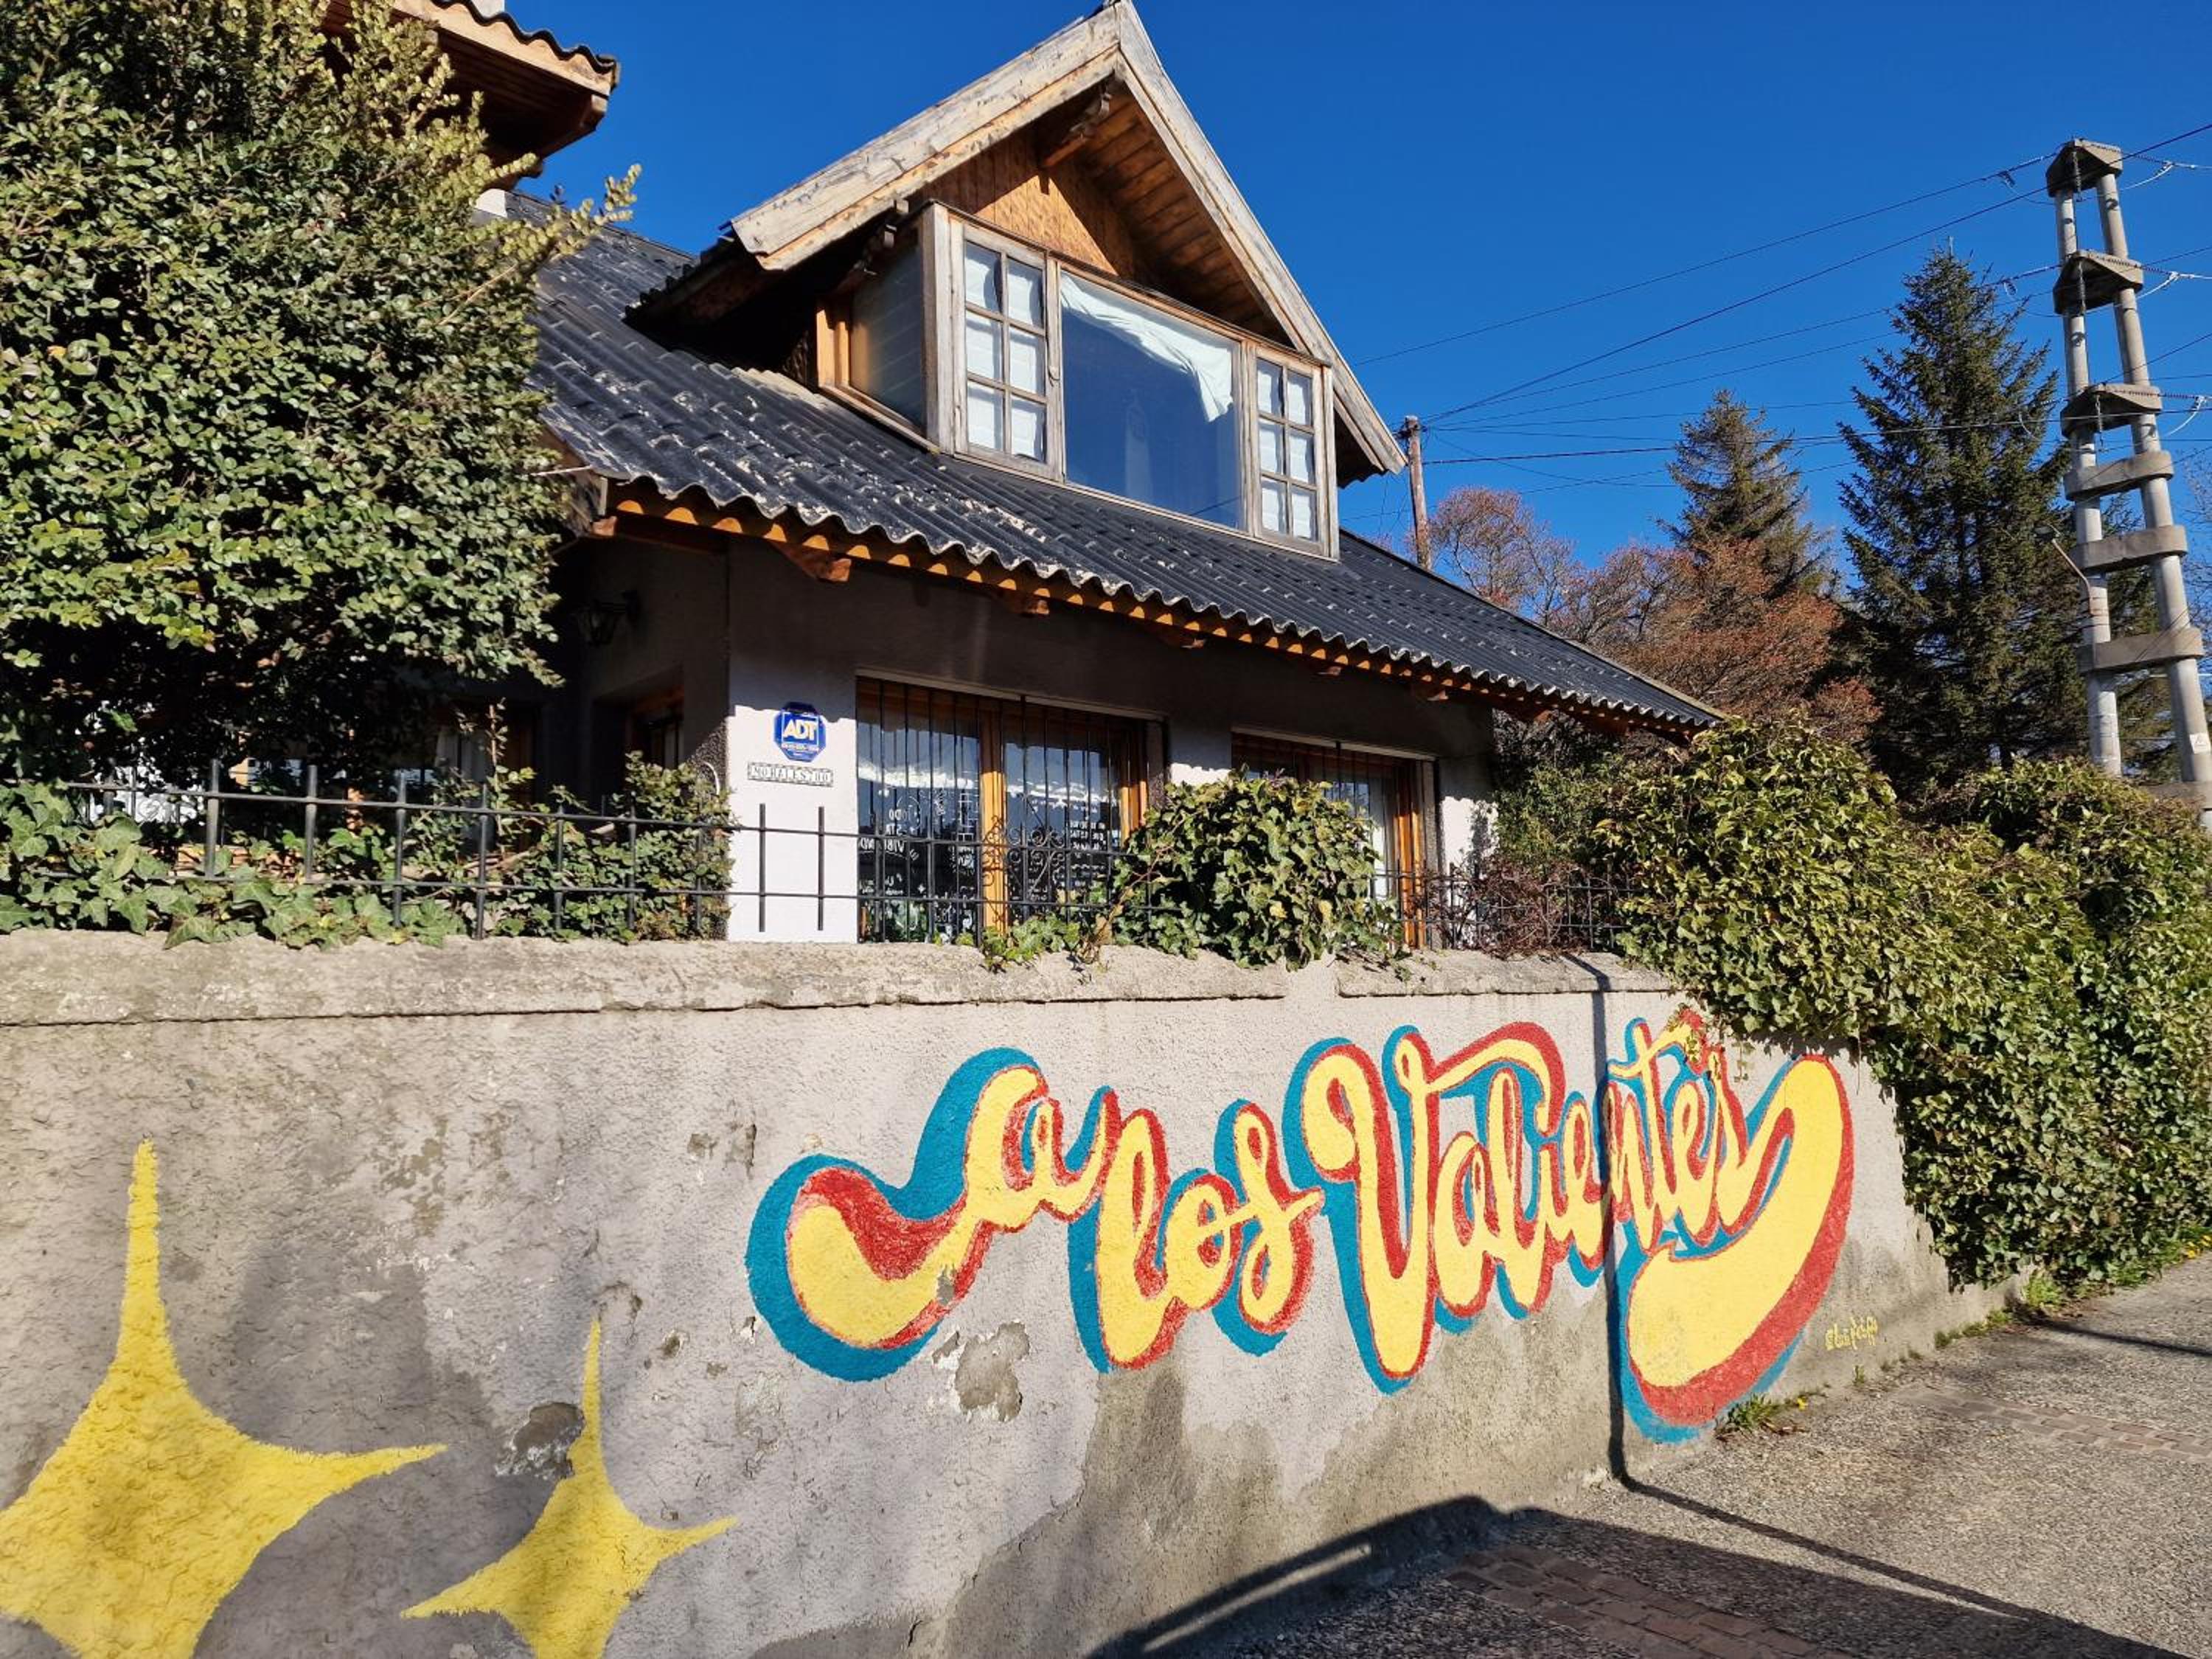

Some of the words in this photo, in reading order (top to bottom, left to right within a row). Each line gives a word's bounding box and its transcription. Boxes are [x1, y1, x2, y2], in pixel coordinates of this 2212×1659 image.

[782, 719, 817, 741] ADT
[1068, 1097, 1326, 1374] los
[1282, 1010, 1854, 1444] Valientes
